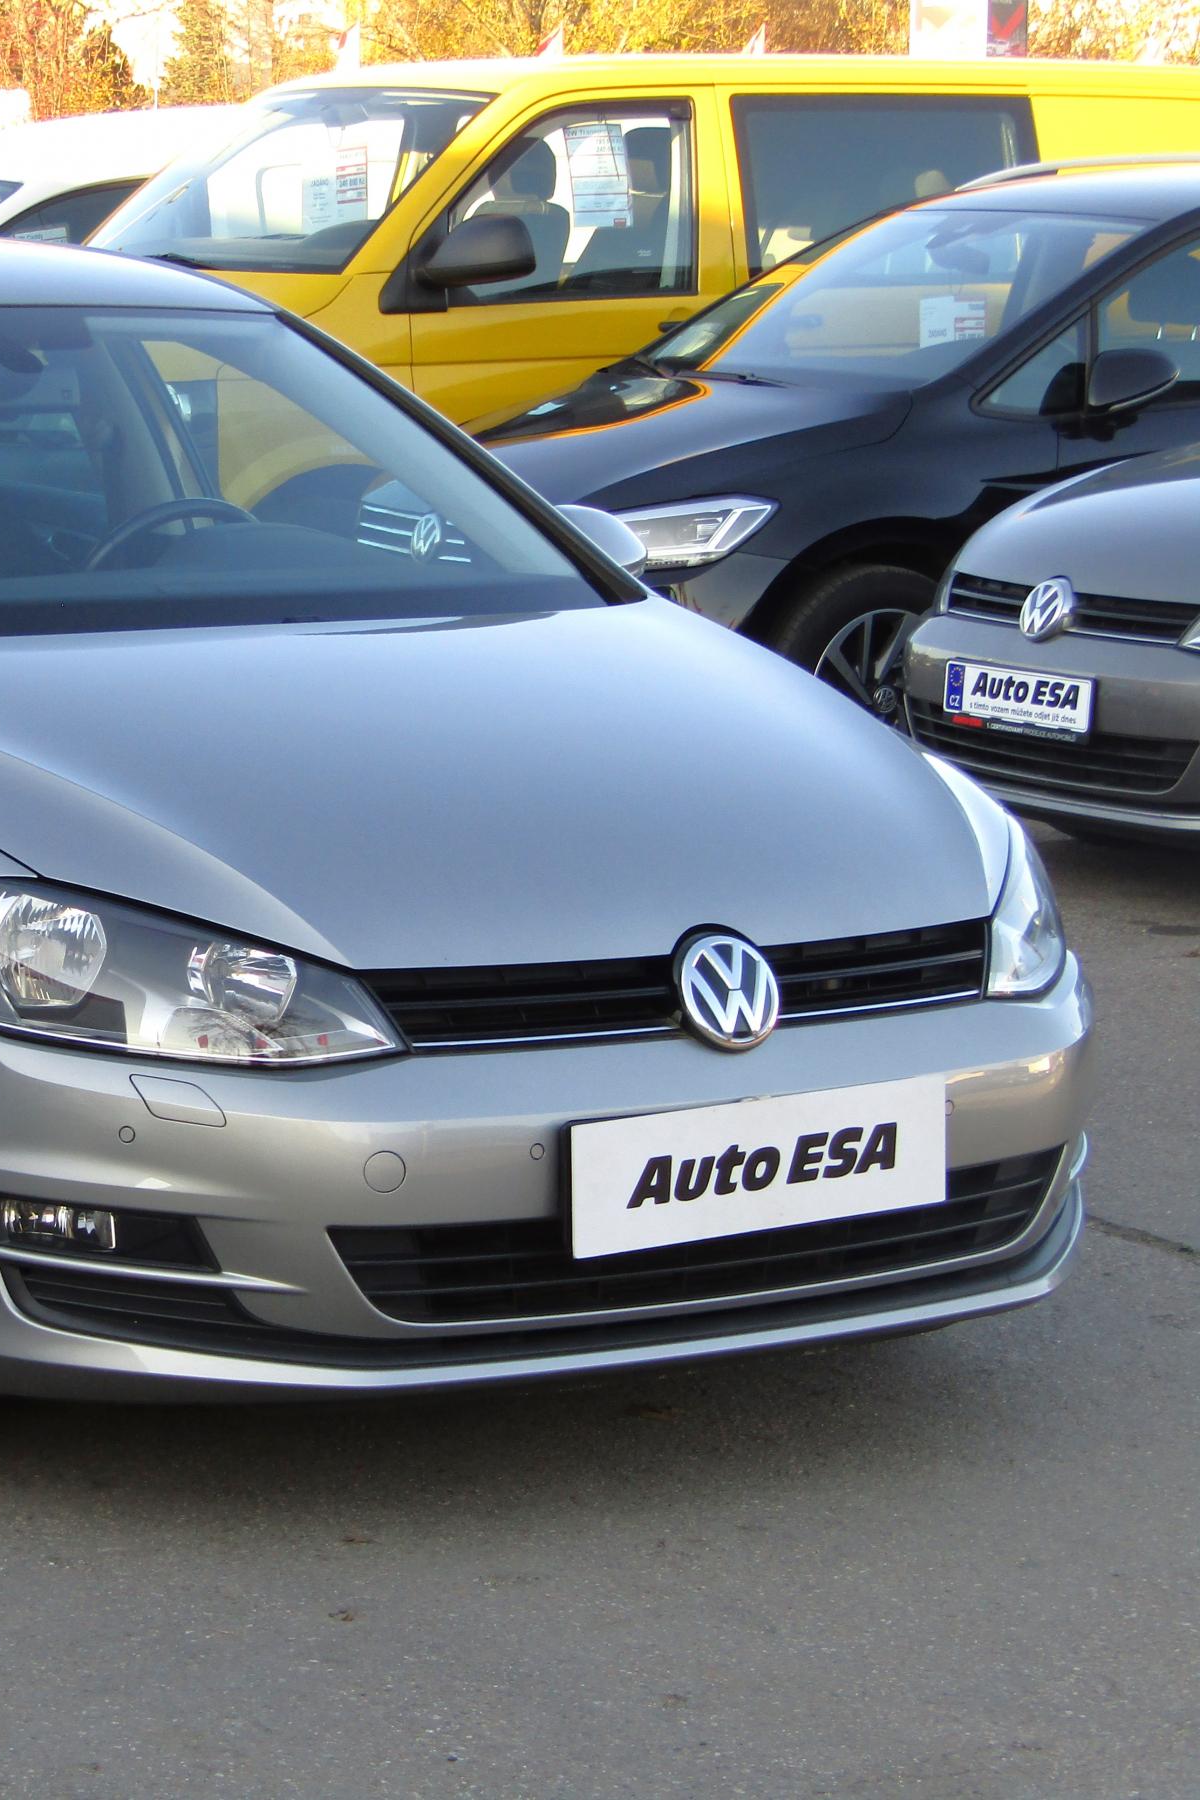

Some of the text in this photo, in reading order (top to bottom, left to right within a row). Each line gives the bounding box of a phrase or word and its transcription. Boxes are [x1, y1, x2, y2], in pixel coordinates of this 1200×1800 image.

[949, 695, 960, 707] CZ
[970, 671, 1080, 711] Auto ESA
[1061, 714, 1077, 724] dnes
[685, 939, 777, 1040] VW
[626, 1121, 898, 1210] Auto ESA
